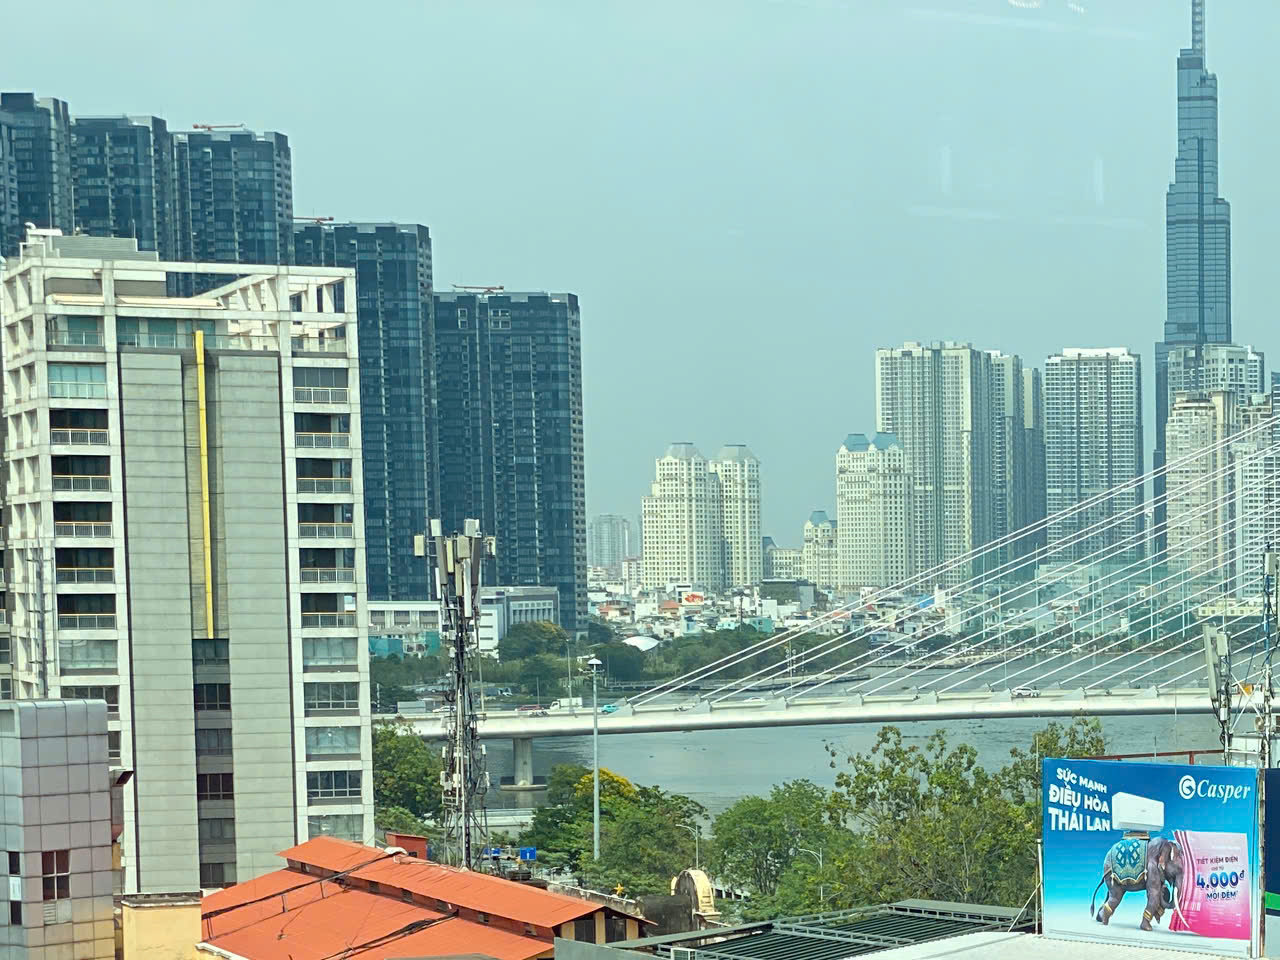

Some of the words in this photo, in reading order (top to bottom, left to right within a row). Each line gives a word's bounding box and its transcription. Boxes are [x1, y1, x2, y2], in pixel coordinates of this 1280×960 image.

[1057, 768, 1077, 784] SỨC
[1079, 777, 1107, 793] MẠNH
[1197, 779, 1251, 804] Casper
[1049, 782, 1080, 808] ĐIỀU
[1084, 794, 1110, 814] HÒA
[1048, 805, 1083, 831] THÁI
[1086, 815, 1110, 831] LAN
